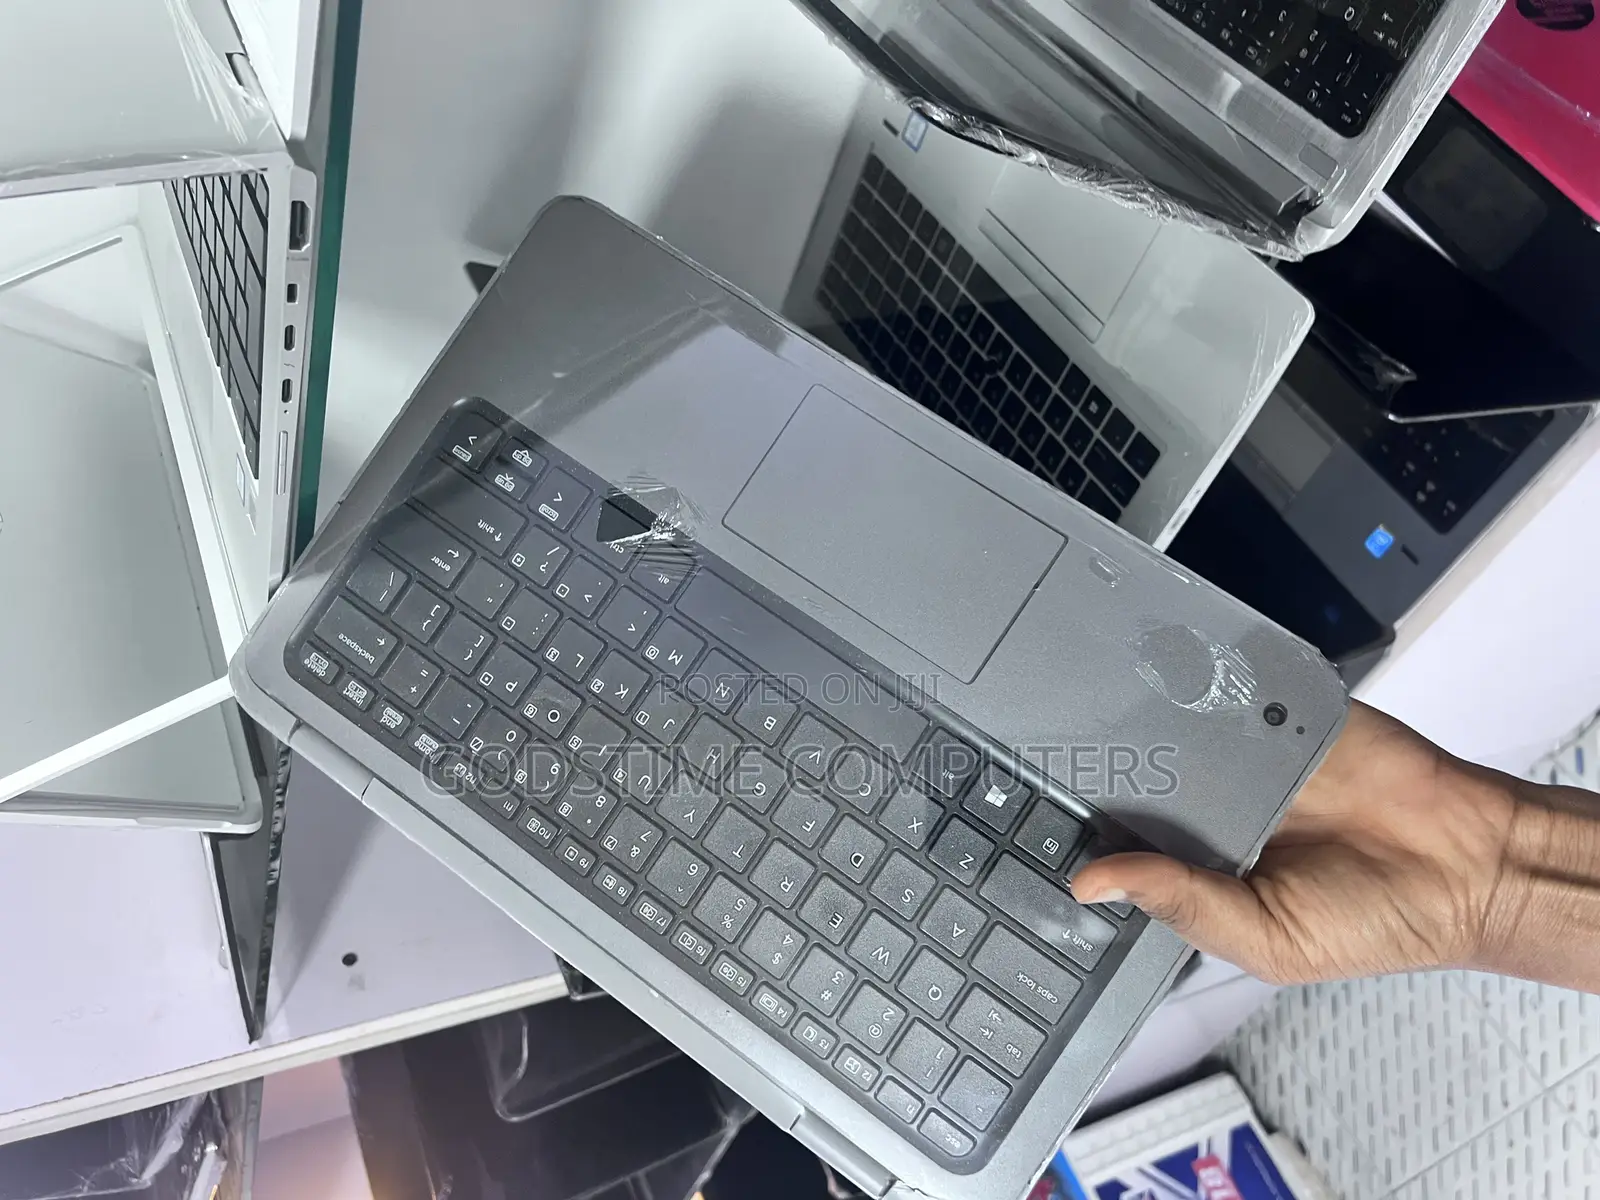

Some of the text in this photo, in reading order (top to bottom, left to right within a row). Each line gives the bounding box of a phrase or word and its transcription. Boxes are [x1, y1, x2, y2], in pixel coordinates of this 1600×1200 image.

[1344, 6, 1355, 21] Q
[540, 503, 557, 519] scroll
[477, 519, 494, 532] shift
[431, 555, 450, 570] enter
[658, 573, 669, 583] alt
[338, 633, 374, 663] backspace
[575, 653, 583, 666] L
[667, 649, 682, 664] M
[304, 658, 325, 676] delete
[505, 680, 517, 691] P
[614, 683, 628, 698] K
[715, 681, 729, 697] N
[342, 687, 363, 705] insert
[379, 714, 397, 728] end
[547, 709, 559, 721] O
[763, 715, 776, 730] B
[662, 718, 674, 728] J
[414, 740, 434, 758] home
[705, 748, 720, 764] H
[808, 750, 823, 763] V
[637, 774, 651, 789] U
[941, 768, 954, 782] alt
[752, 781, 765, 797] G
[858, 782, 871, 795] C
[683, 805, 694, 822] Y
[802, 820, 815, 831] F
[907, 816, 922, 832] X
[538, 826, 551, 839] f10
[732, 844, 744, 857] T
[1043, 838, 1057, 850] fn
[579, 857, 588, 867] f9
[847, 848, 864, 866] D
[958, 852, 973, 868] Z
[780, 875, 793, 891] R
[617, 886, 627, 896] f8
[901, 888, 914, 904] S
[656, 916, 666, 926] f7
[826, 912, 843, 929] E
[952, 922, 965, 938] A
[695, 945, 706, 955] f6
[1072, 933, 1092, 952] shift
[871, 946, 892, 964] W
[736, 976, 746, 986] f5
[1014, 971, 1057, 1003] caps lock
[928, 984, 941, 1002] Q
[777, 1006, 787, 1017] f4
[818, 1038, 829, 1049] f3
[1004, 1043, 1021, 1057] tab
[861, 1069, 872, 1081] f2
[945, 1133, 960, 1147] esc
